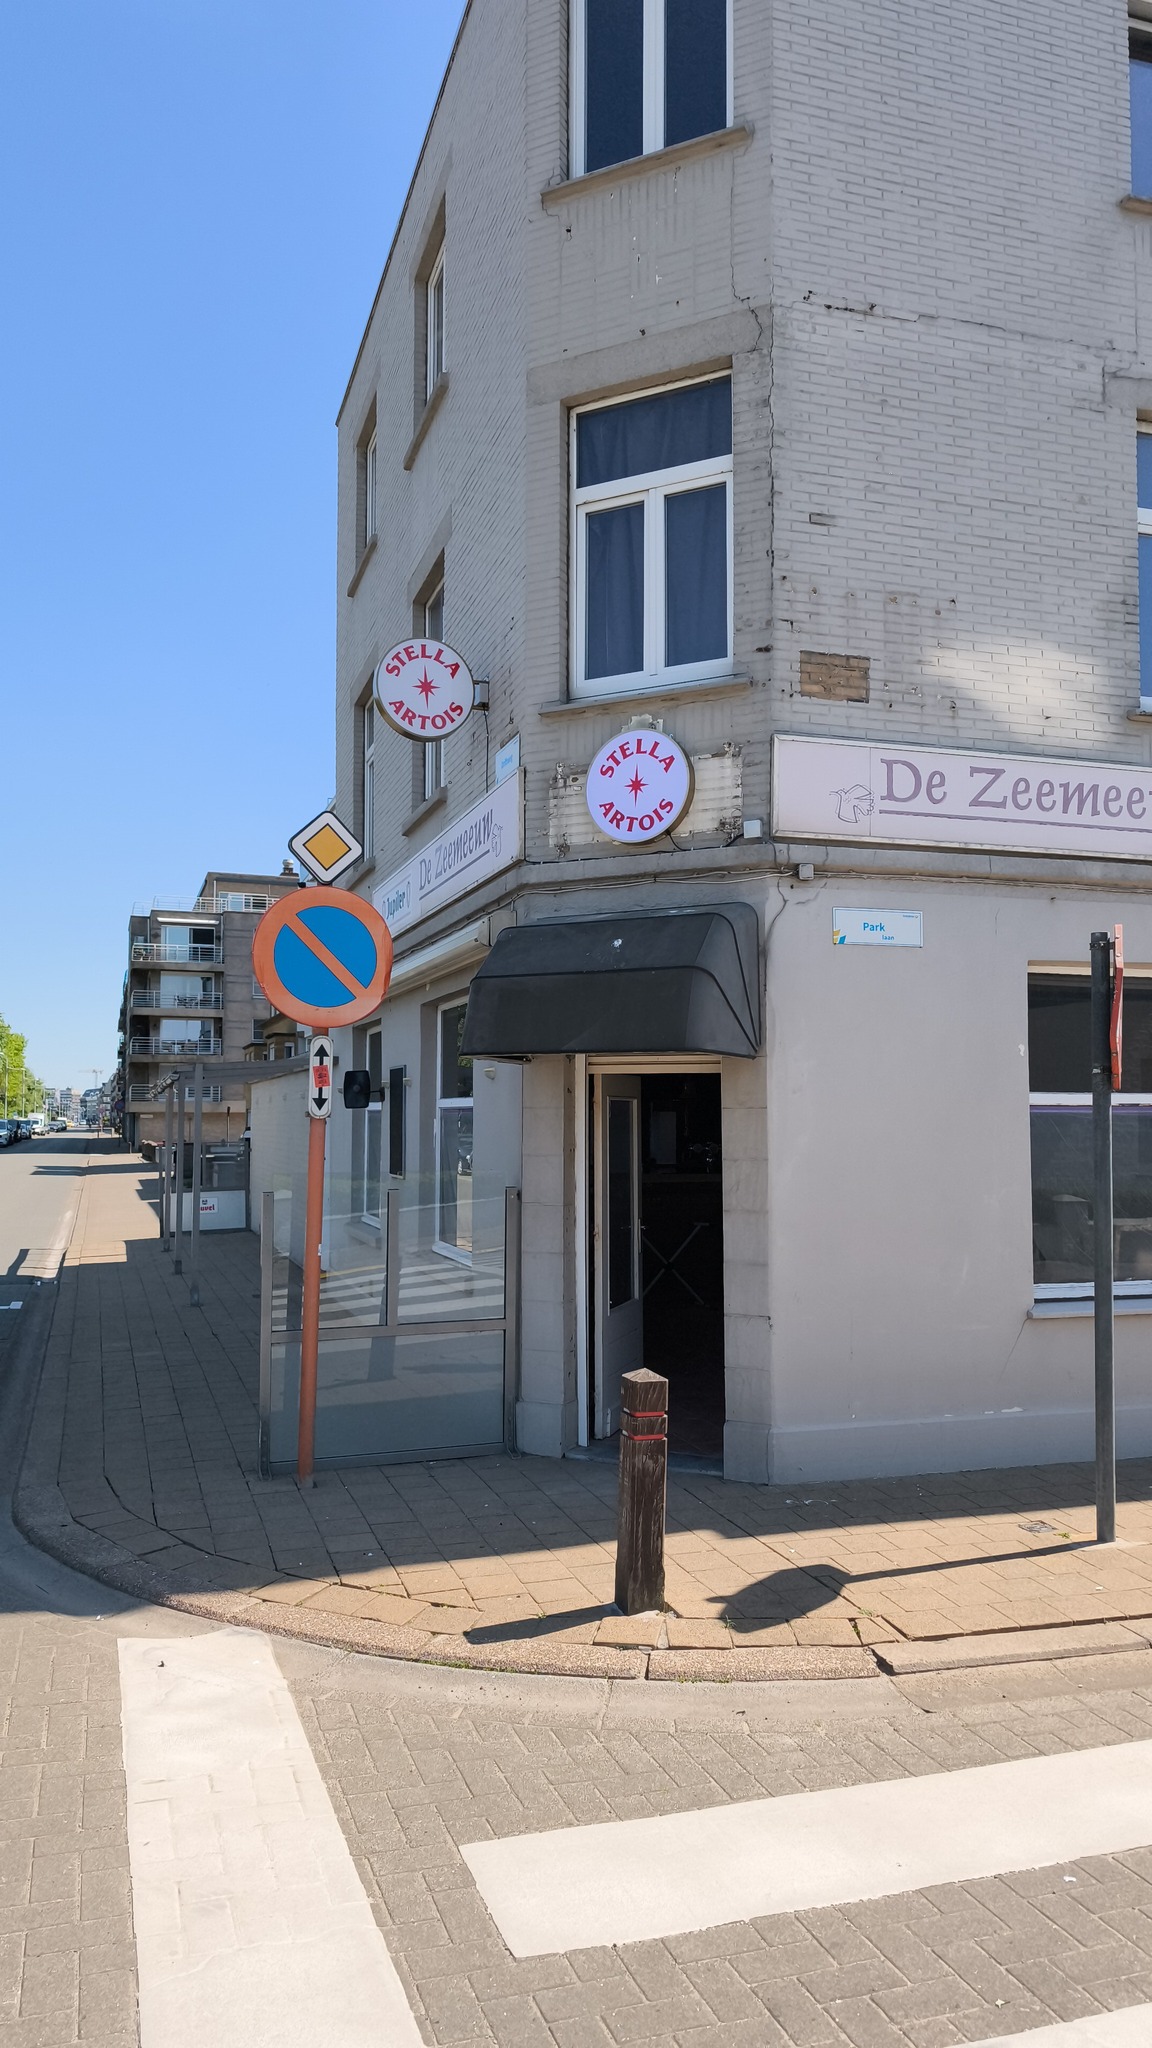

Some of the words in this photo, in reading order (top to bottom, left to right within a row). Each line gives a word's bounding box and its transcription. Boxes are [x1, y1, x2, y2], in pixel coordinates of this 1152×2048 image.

[386, 644, 460, 679] STELLA
[389, 700, 463, 730] ARTOIS
[600, 738, 675, 778] STELLA
[880, 758, 947, 805] De
[969, 765, 1152, 820] Zeemee
[599, 798, 673, 832] ARTOIS
[419, 858, 431, 890] De
[435, 808, 493, 879] Zeemeeuw
[386, 890, 405, 919] Jupiler
[863, 922, 885, 932] Park
